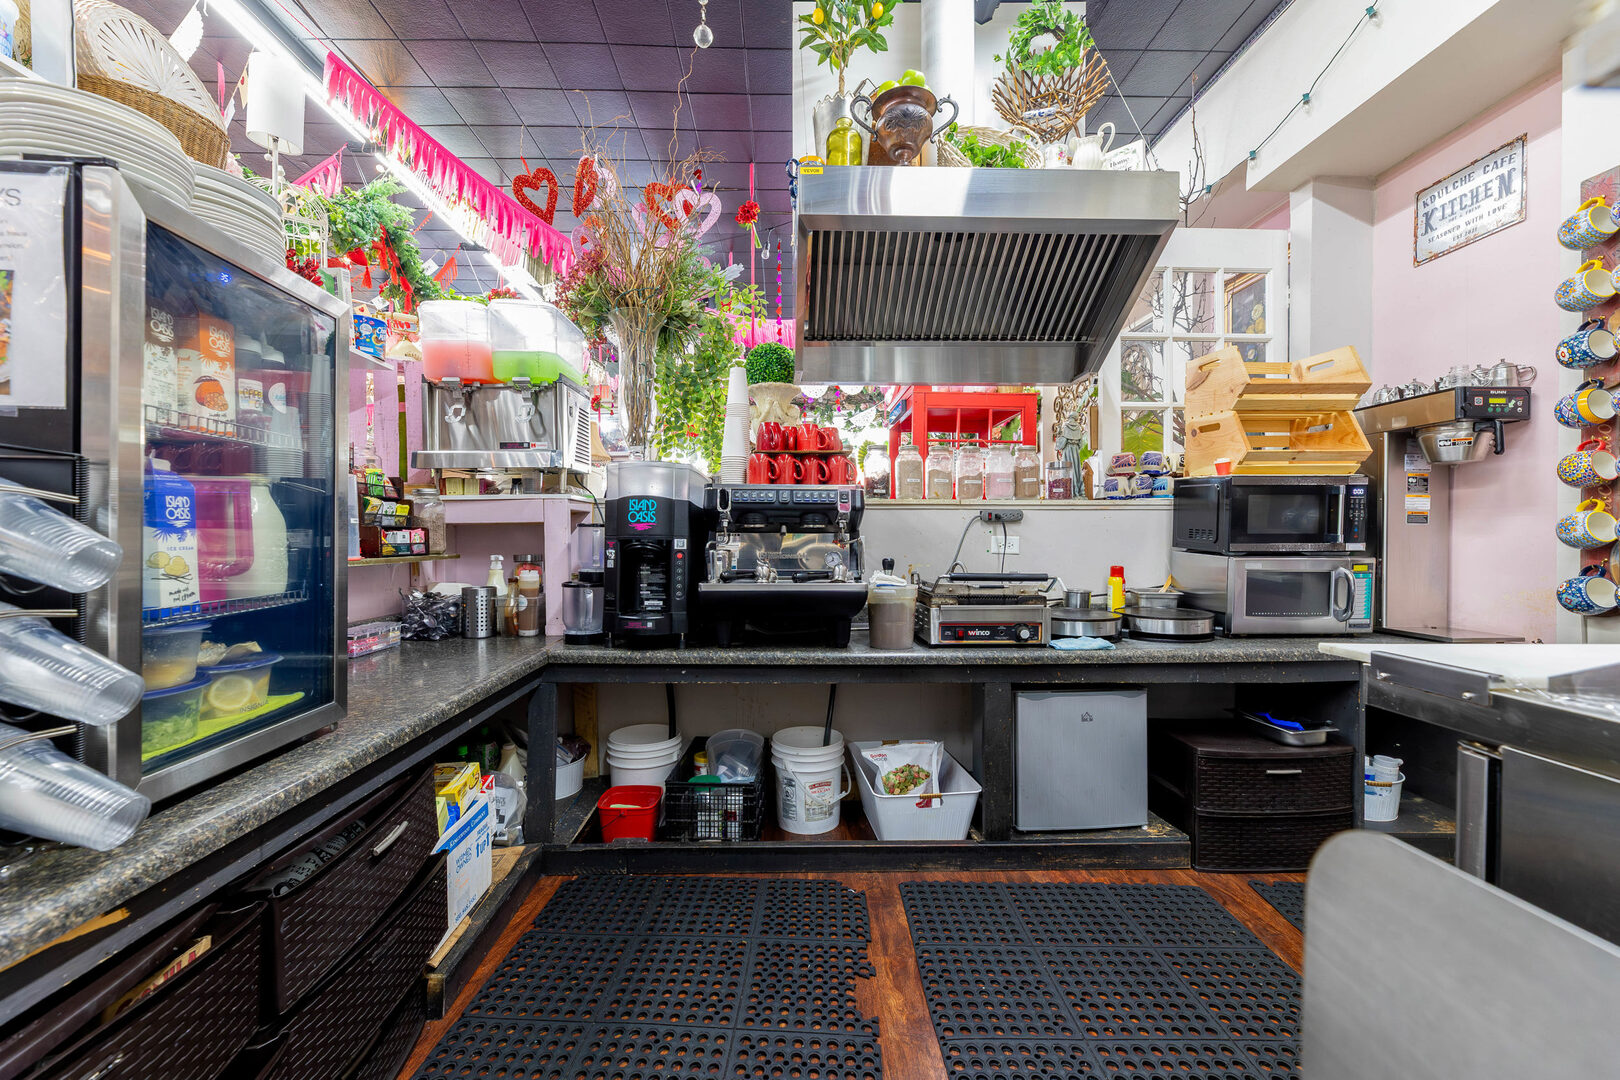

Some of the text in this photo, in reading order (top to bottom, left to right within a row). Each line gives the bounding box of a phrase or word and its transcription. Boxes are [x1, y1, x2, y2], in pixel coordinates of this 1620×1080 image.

[1422, 152, 1517, 209] KDULCHE CAFE
[1420, 167, 1517, 237] KITCHEN
[1427, 202, 1507, 244] SEASONED WITH LOVE
[165, 495, 191, 508] ISLAND
[628, 498, 657, 511] ISLAND
[165, 507, 191, 520] OASIS
[628, 510, 656, 523] OASIS
[967, 628, 990, 636] winco
[240, 699, 269, 713] INSIGNIA
[480, 839, 487, 854] UP
